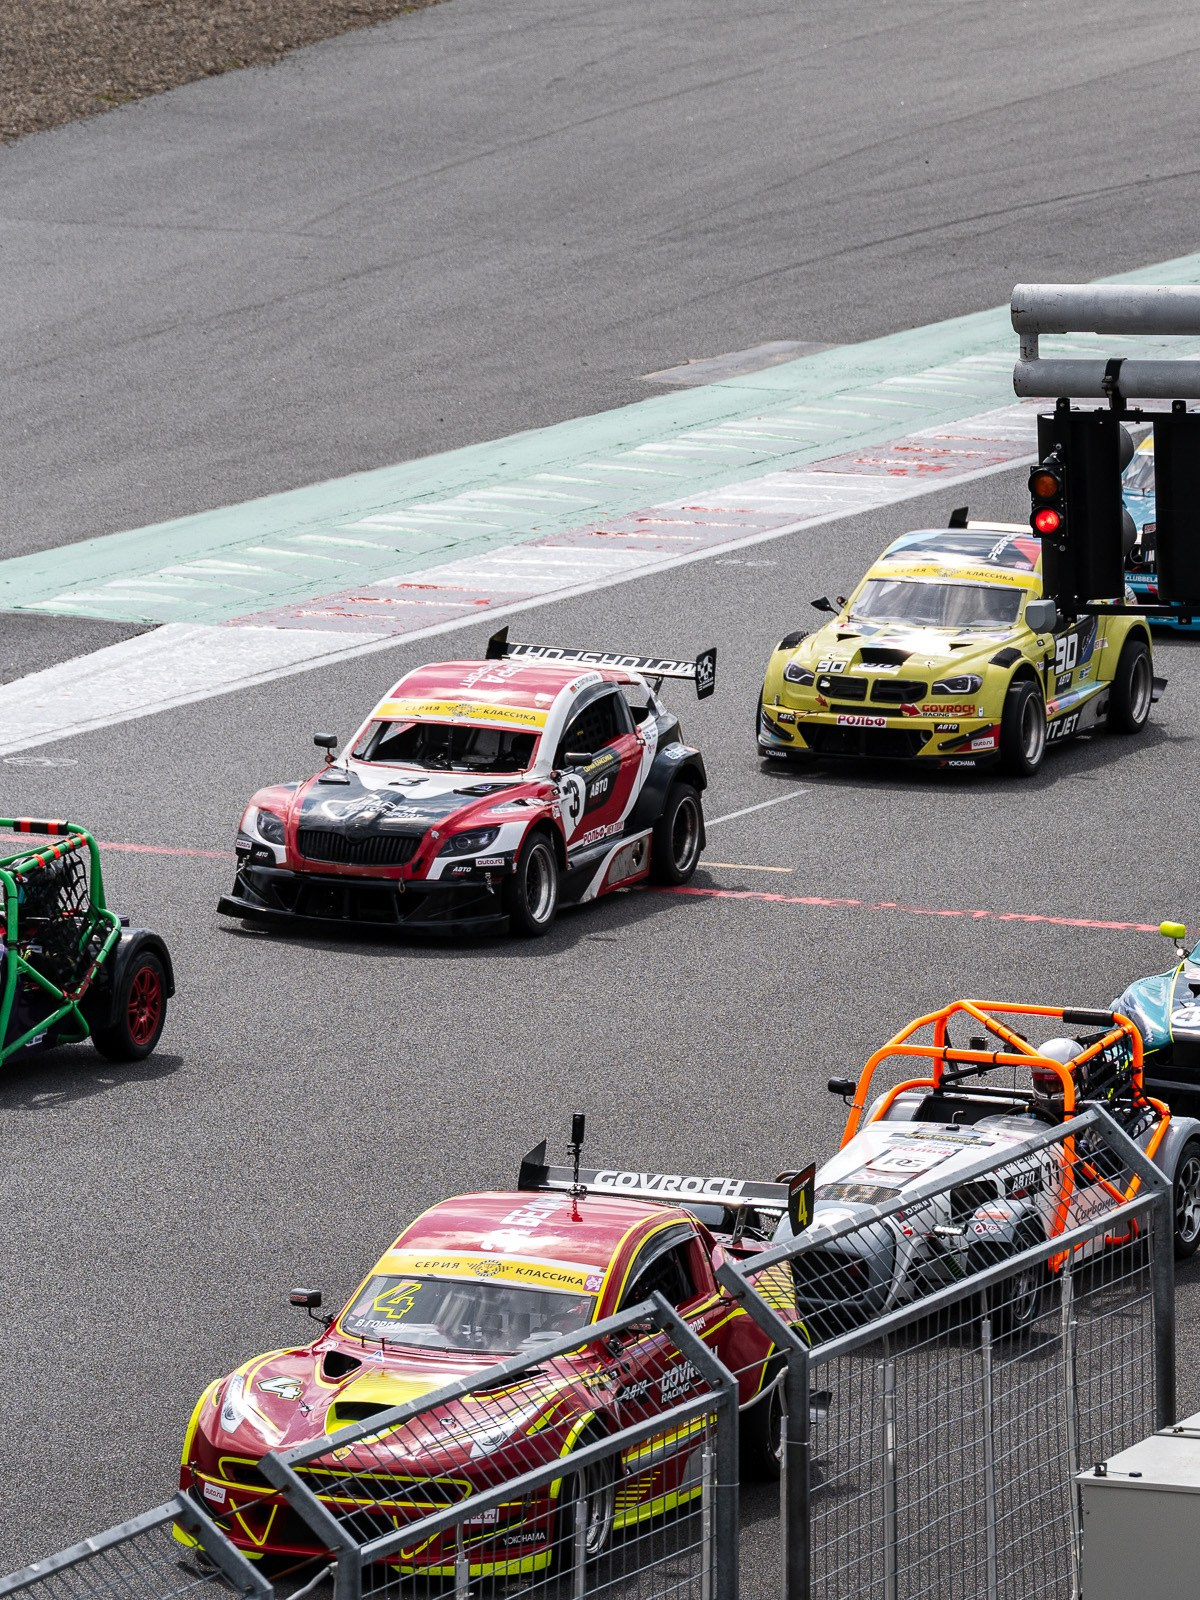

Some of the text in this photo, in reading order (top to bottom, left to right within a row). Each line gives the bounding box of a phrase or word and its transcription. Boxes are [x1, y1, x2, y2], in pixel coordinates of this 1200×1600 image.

[966, 571, 1015, 582] КЛАССИКА
[511, 645, 697, 676] MOTORSPORT
[1055, 632, 1079, 675] 90
[815, 660, 847, 673] 90
[483, 709, 537, 721] КЛАССИКА
[922, 705, 976, 713] GOVROCH
[837, 716, 886, 727] РОЛЬФ
[1046, 712, 1079, 740] ITJET
[562, 779, 580, 819] 3
[590, 778, 608, 799] АВТО
[593, 1171, 747, 1196] GOVROCH
[1012, 1171, 1035, 1191] АВТО
[798, 1190, 808, 1226] 4
[415, 1261, 583, 1286] СЕРИЯ КЛАССИКА
[373, 1283, 422, 1319] 4
[257, 1376, 303, 1400] 4
[205, 1487, 224, 1498] auto.ru
